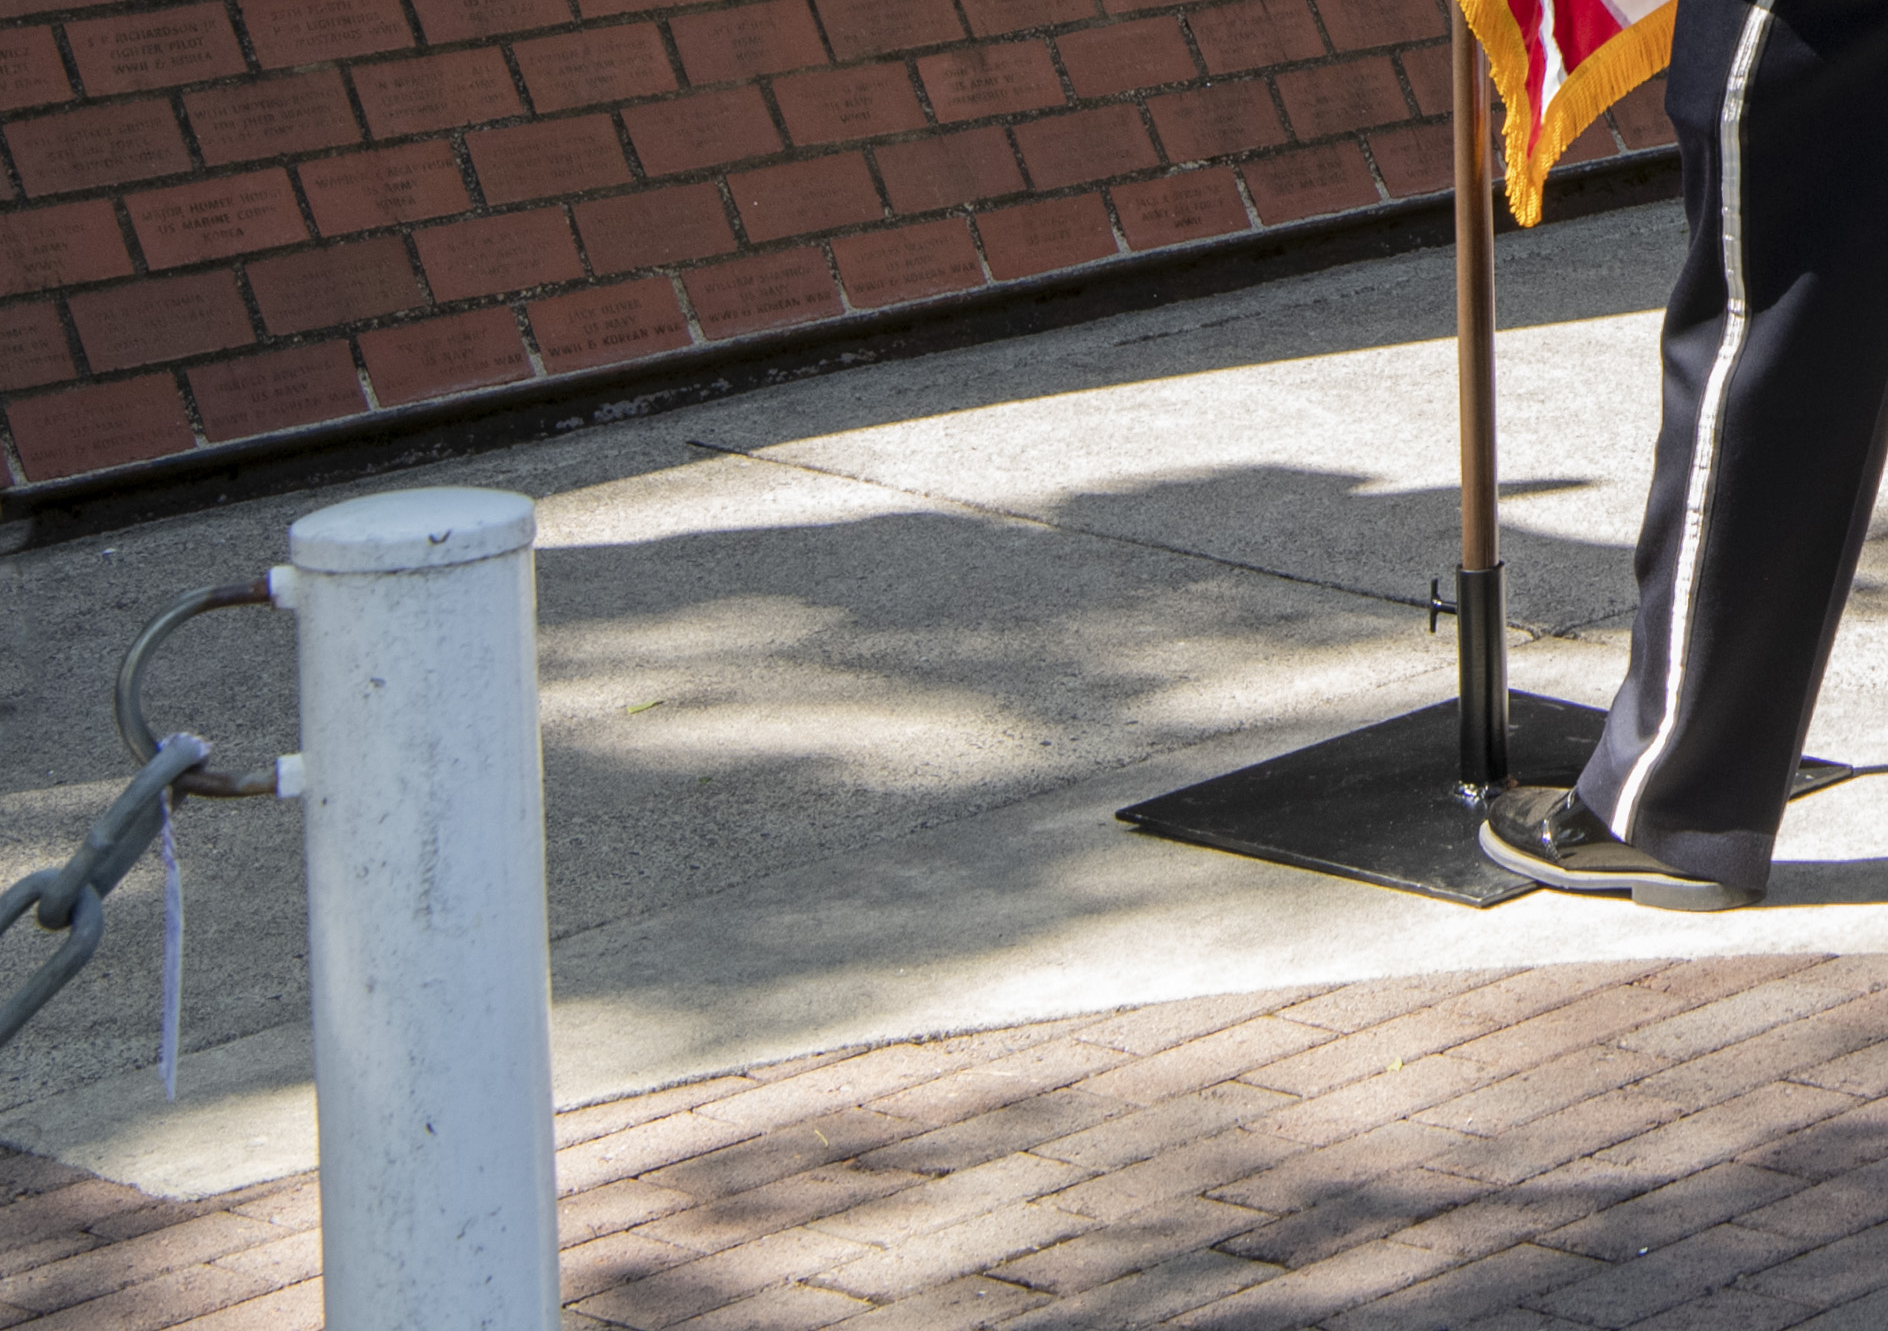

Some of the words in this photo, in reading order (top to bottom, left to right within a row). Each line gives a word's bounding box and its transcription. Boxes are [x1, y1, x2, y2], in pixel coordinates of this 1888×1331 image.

[182, 213, 232, 231] MARINE
[601, 298, 642, 315] OLIVER
[604, 315, 637, 331] NAVY
[547, 342, 584, 359] WWII
[602, 327, 650, 347] KOREAN
